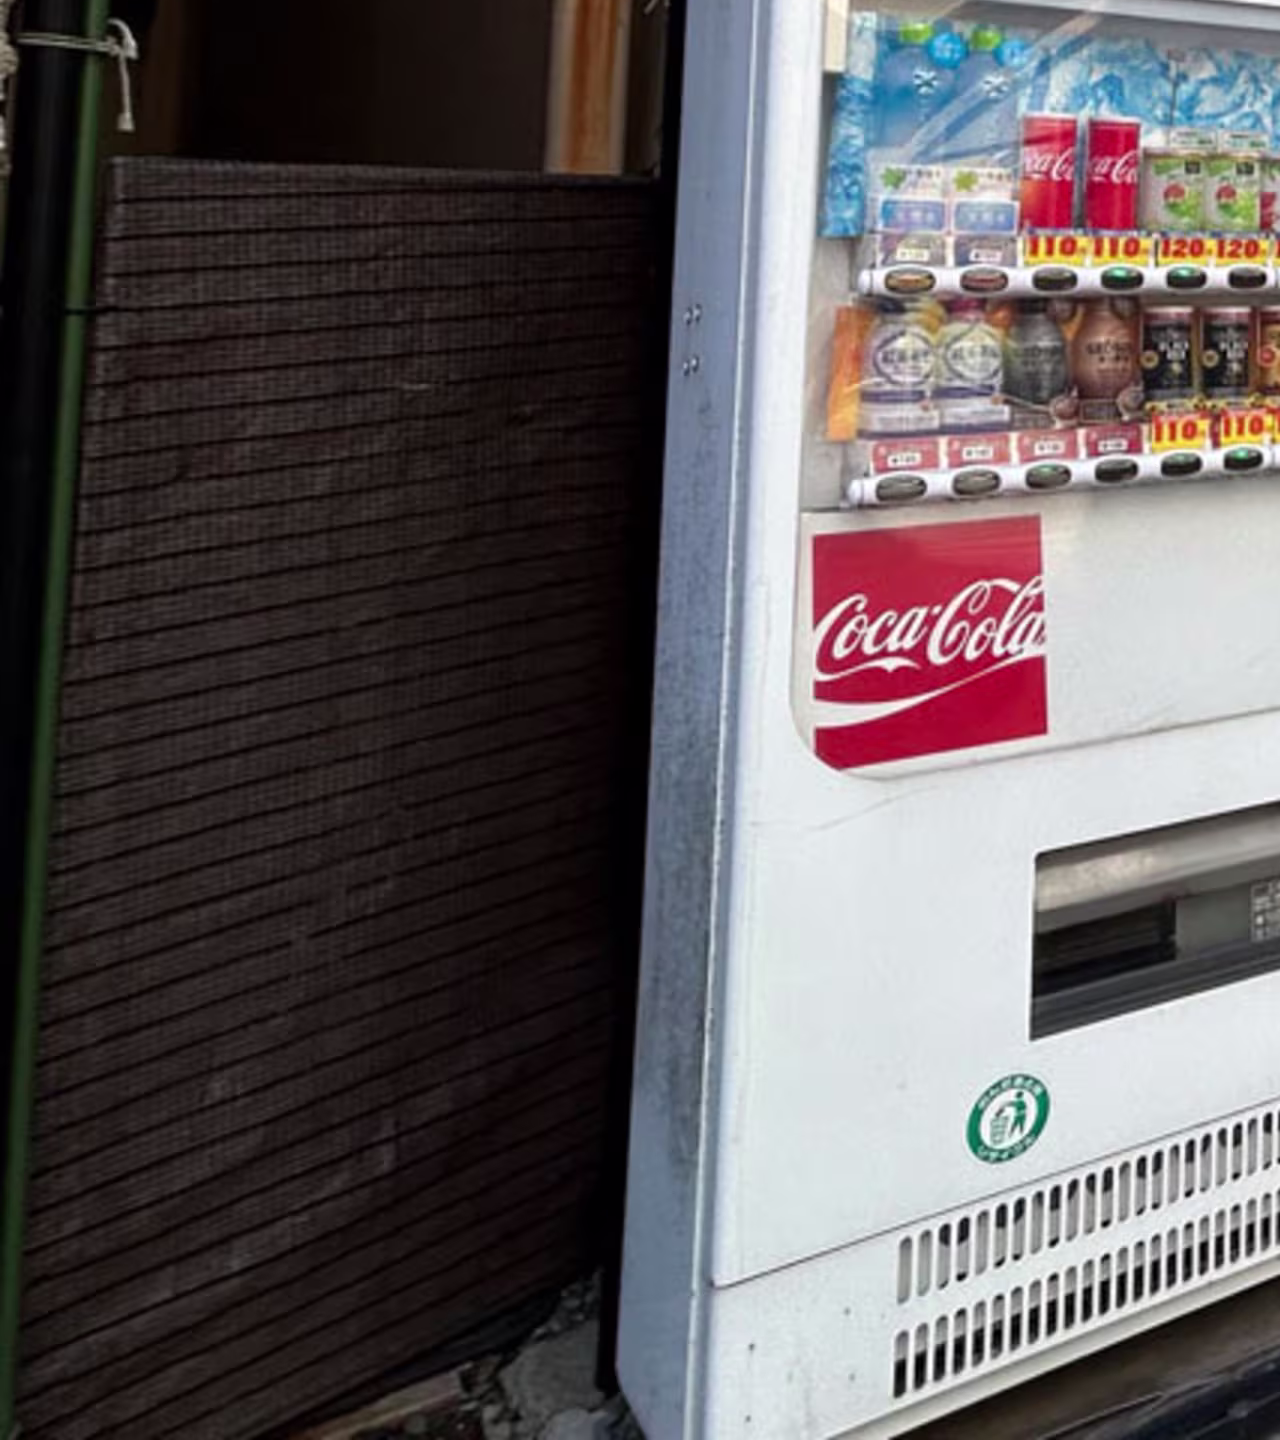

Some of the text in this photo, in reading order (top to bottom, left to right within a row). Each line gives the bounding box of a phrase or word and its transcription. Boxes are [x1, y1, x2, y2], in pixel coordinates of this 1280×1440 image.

[1029, 236, 1078, 257] 110
[1094, 236, 1141, 258] 110
[1161, 238, 1205, 258] 120
[1217, 239, 1260, 259] 120
[1154, 418, 1198, 443] 110
[1223, 415, 1264, 437] 110
[812, 575, 1046, 682] Coca-Cola
